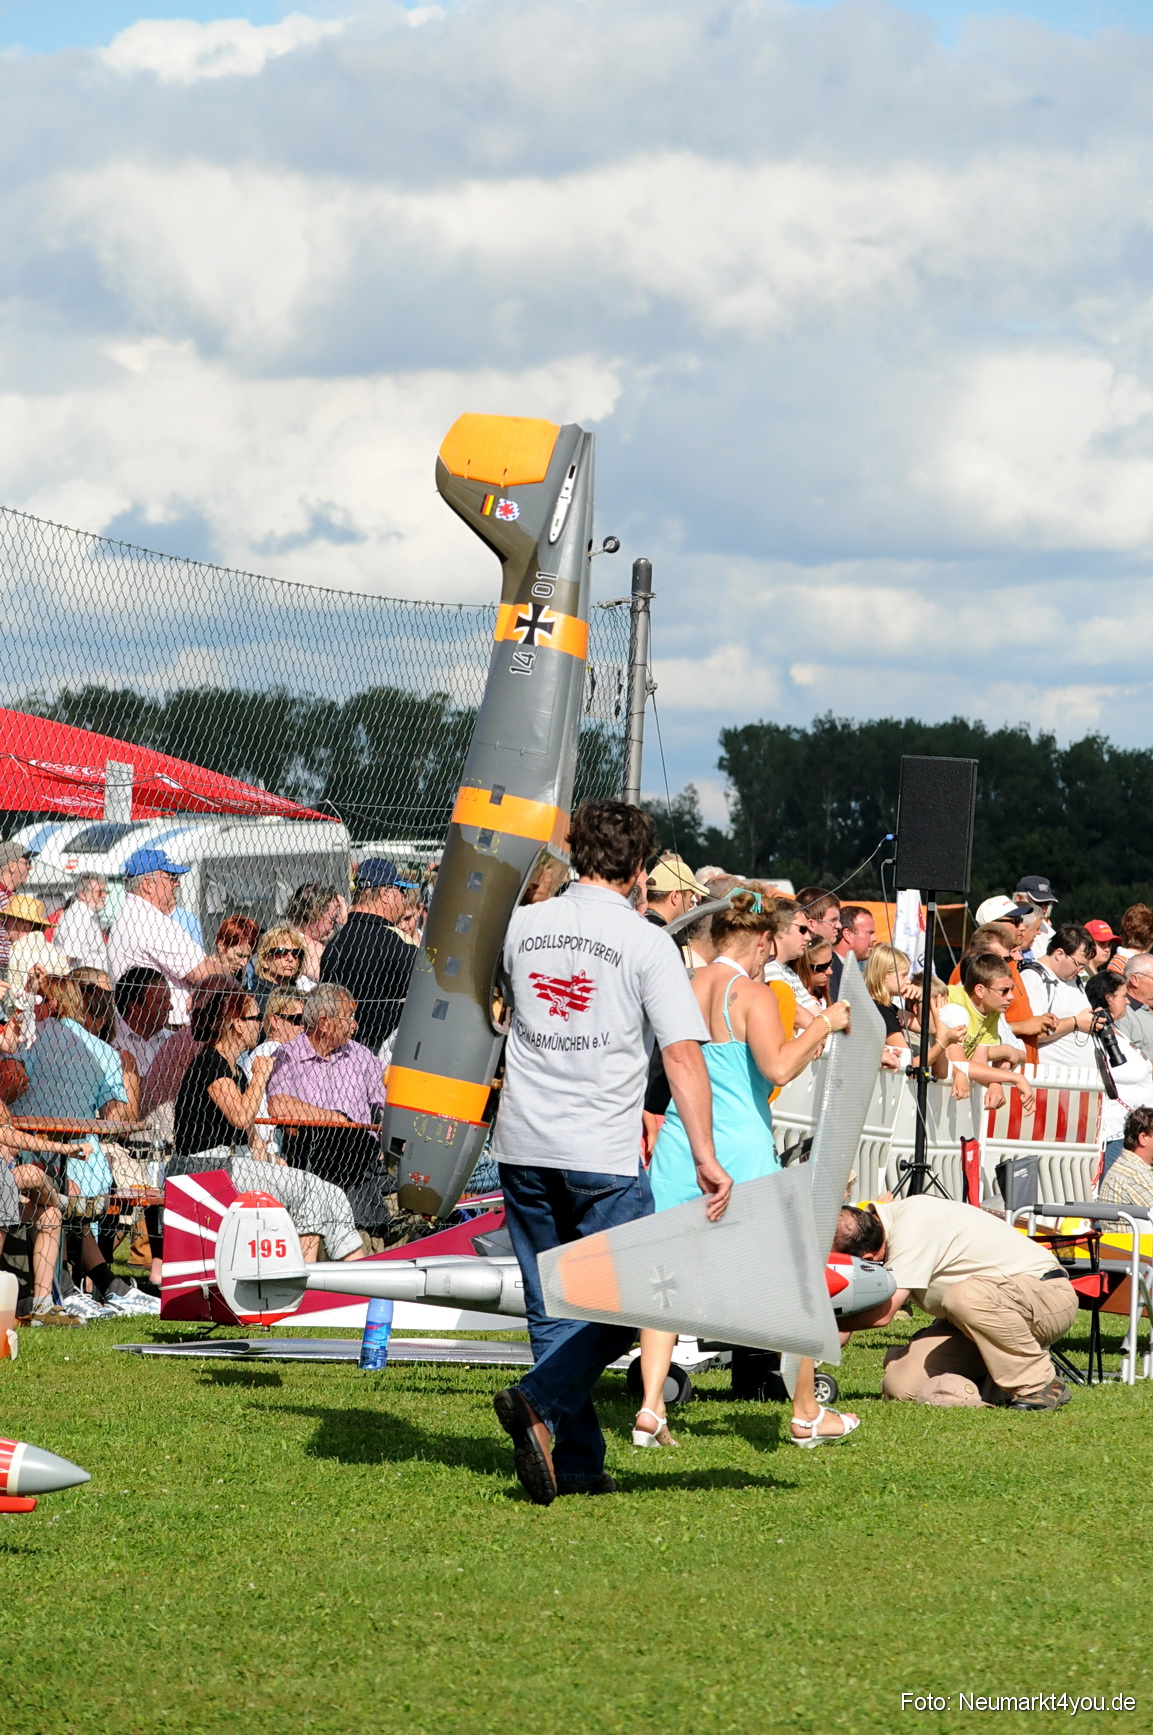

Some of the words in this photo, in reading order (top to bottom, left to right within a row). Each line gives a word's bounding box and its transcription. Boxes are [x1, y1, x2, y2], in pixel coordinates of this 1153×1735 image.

[509, 651, 536, 676] 14
[531, 571, 559, 599] 01
[592, 1031, 610, 1049] e.V.
[247, 1238, 287, 1259] 195
